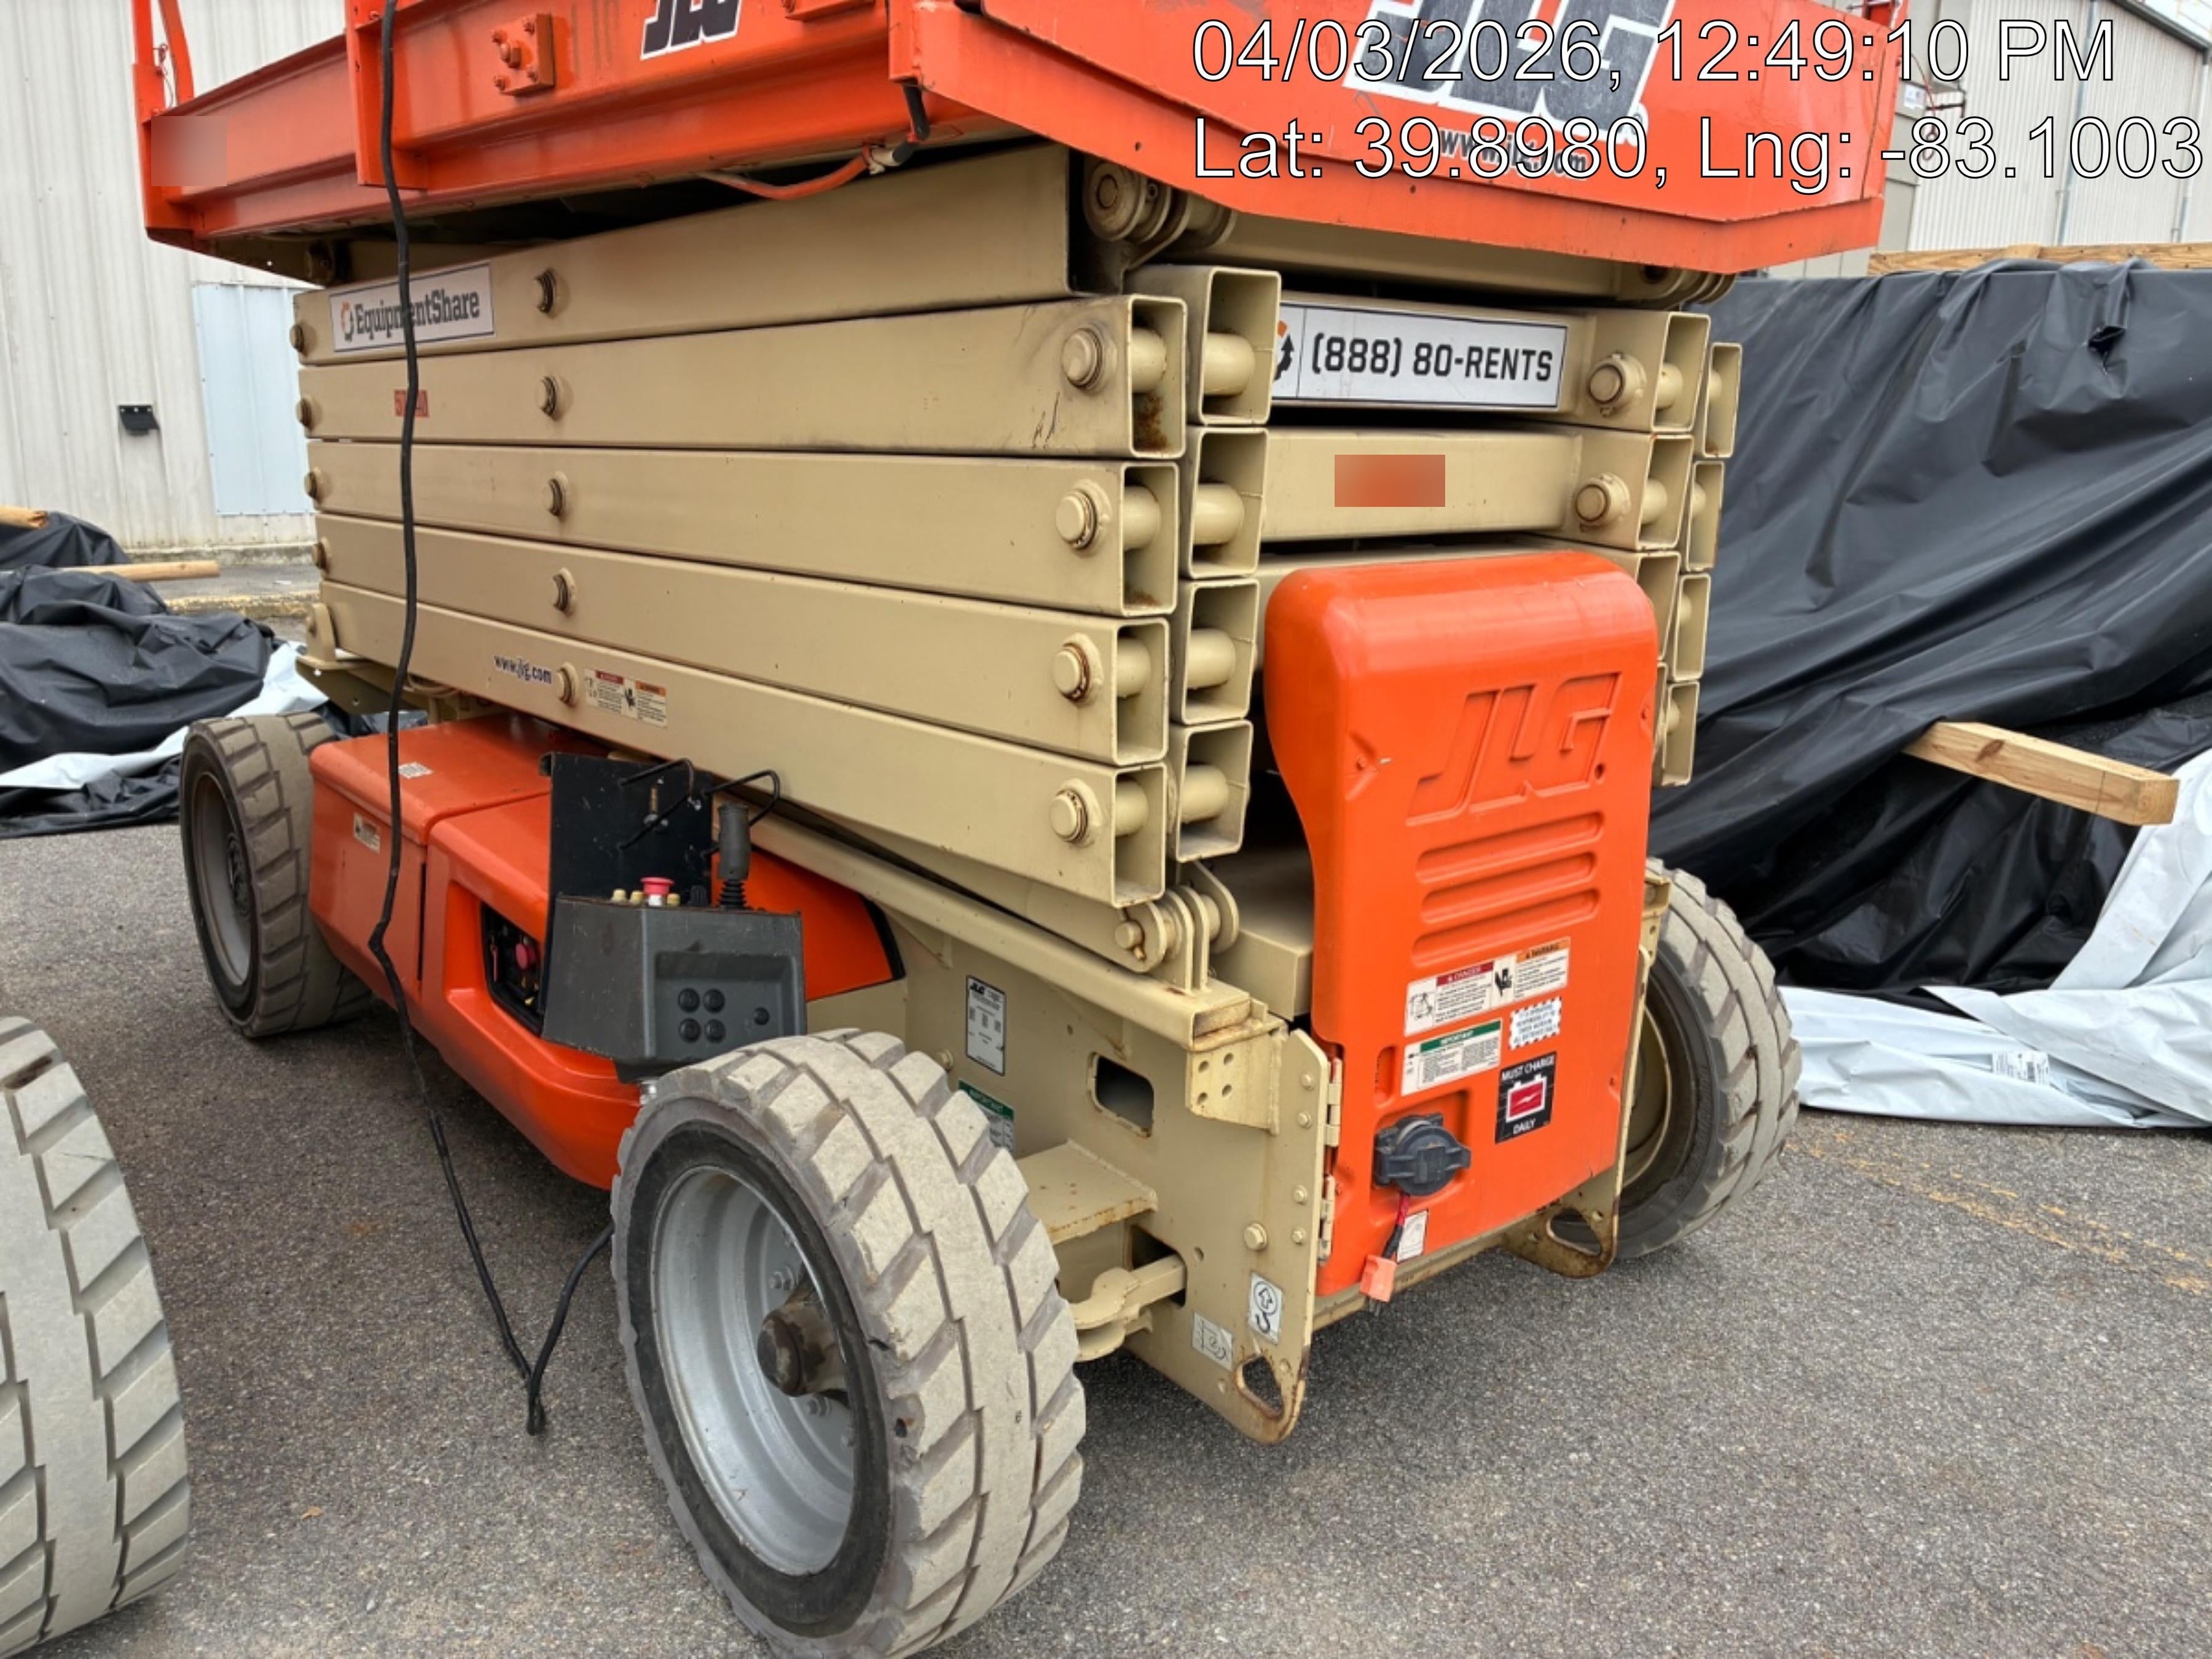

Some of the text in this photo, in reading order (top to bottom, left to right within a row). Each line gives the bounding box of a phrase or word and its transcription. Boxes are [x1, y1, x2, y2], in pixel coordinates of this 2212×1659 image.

[1312, 332, 1553, 382] (888) 80-RENTS
[1406, 671, 1623, 826] JLG
[1502, 1055, 1555, 1081] MUST CHARGE
[1513, 1118, 1536, 1135] DAILY
